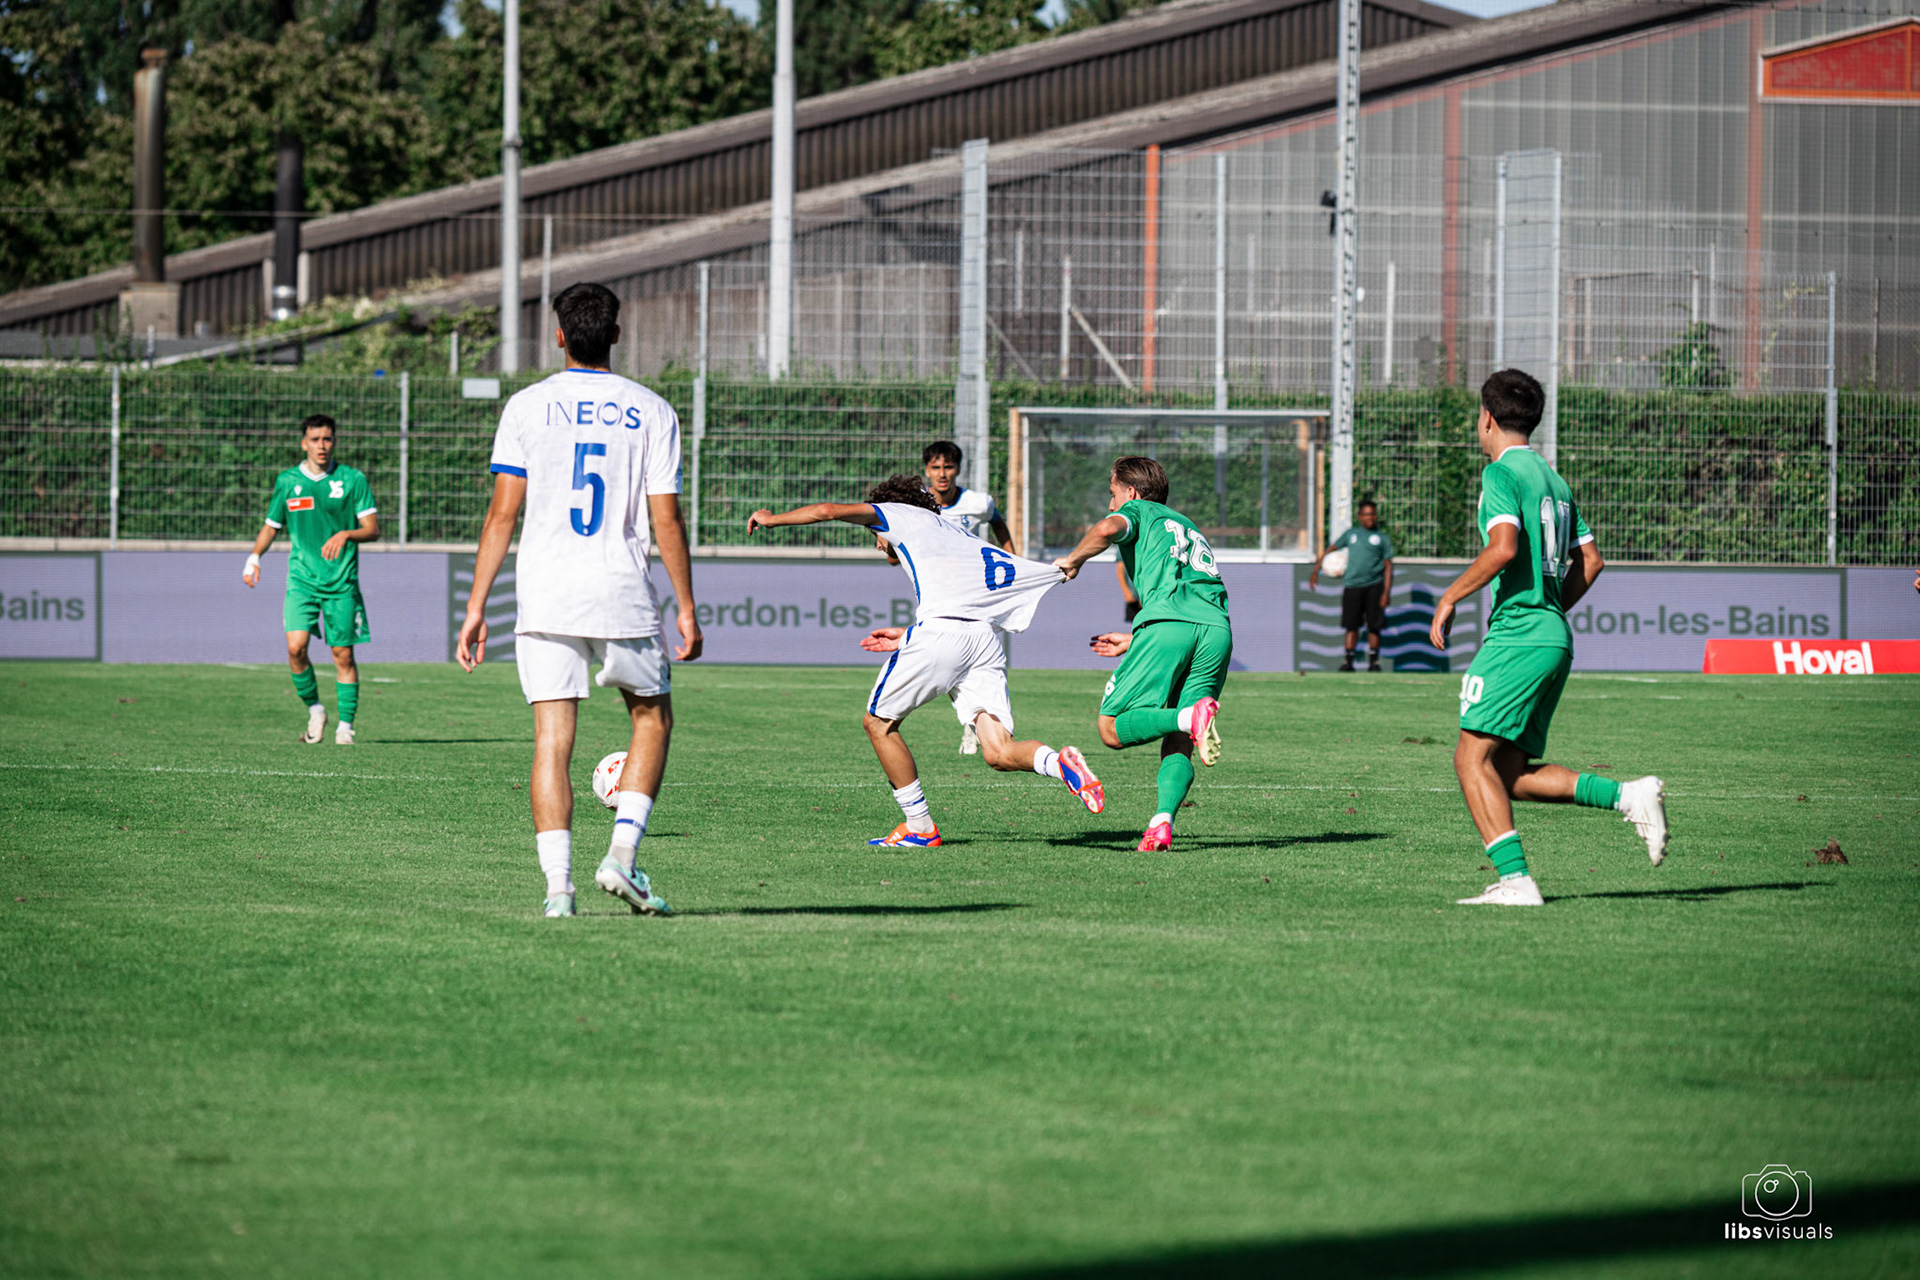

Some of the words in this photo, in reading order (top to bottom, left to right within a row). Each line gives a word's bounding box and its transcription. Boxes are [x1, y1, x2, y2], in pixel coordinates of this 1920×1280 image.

[546, 401, 642, 430] INEOS
[570, 442, 607, 537] 5
[1164, 519, 1221, 578] 16
[980, 547, 1016, 591] 6
[1566, 604, 1831, 636] don-les-Bains
[1772, 641, 1874, 675] Hoval
